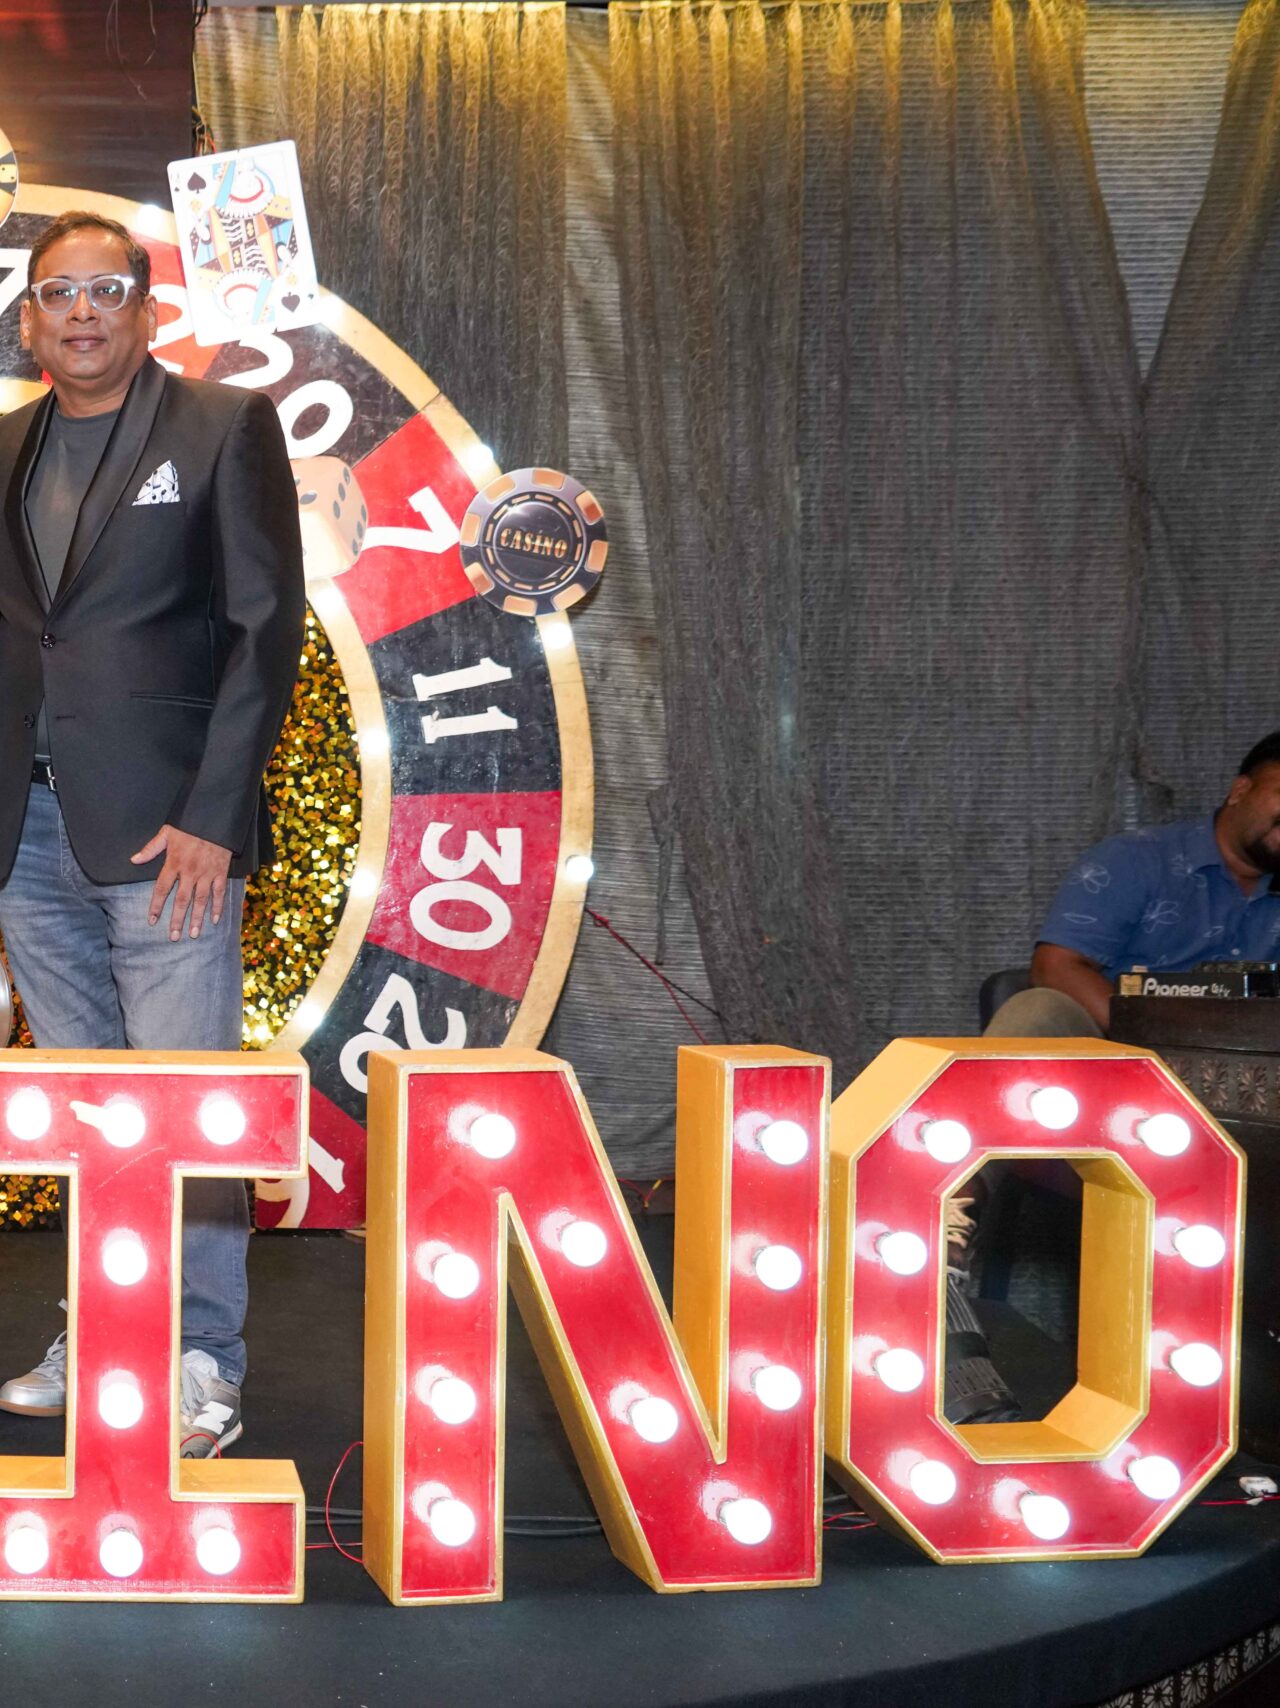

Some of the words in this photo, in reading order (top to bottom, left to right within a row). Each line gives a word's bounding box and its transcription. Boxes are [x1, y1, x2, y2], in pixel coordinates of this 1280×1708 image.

[362, 488, 460, 554] 7
[412, 657, 517, 744] 11
[410, 821, 522, 951] 30
[1143, 977, 1209, 997] Pioneer
